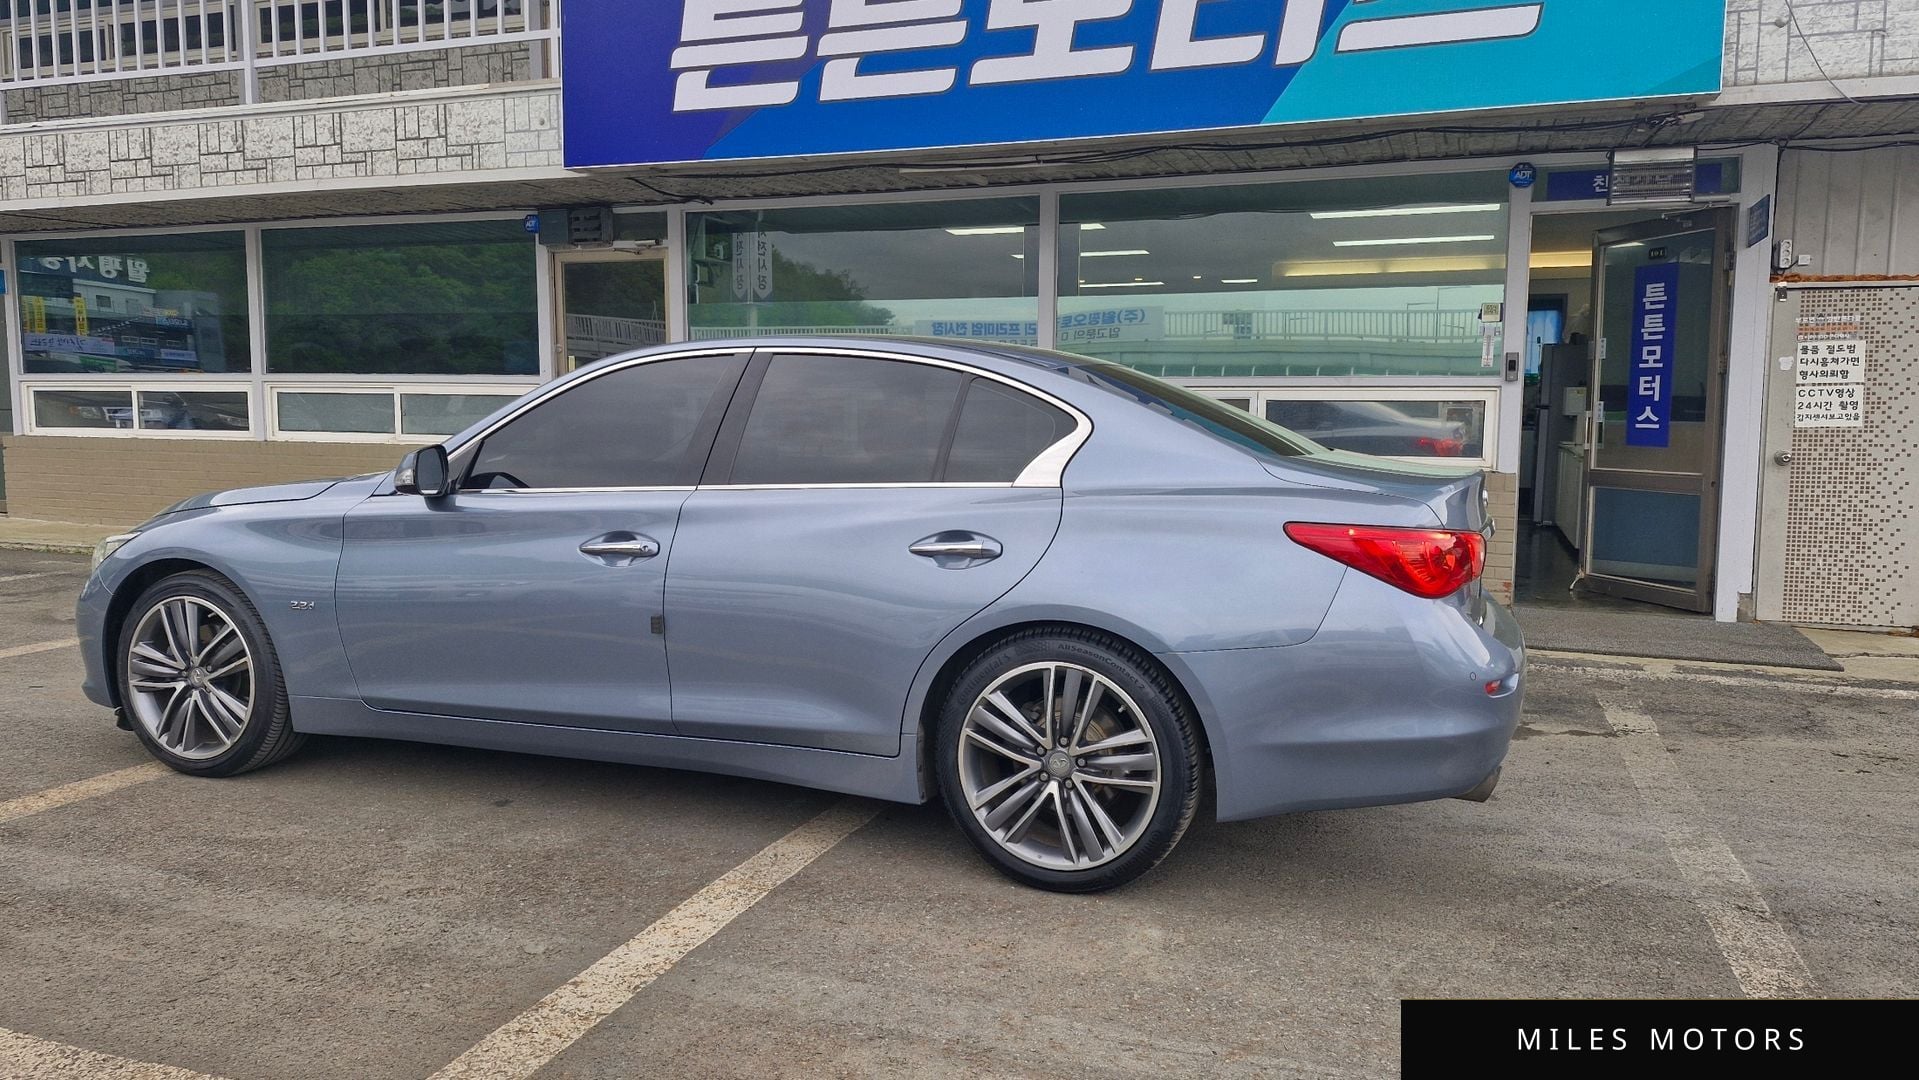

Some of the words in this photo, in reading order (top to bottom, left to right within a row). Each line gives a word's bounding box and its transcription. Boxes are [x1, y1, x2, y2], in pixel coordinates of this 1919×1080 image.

[1513, 170, 1533, 180] ADT
[1635, 282, 1668, 429] 튼튼모터스
[1797, 401, 1833, 411] 24시간
